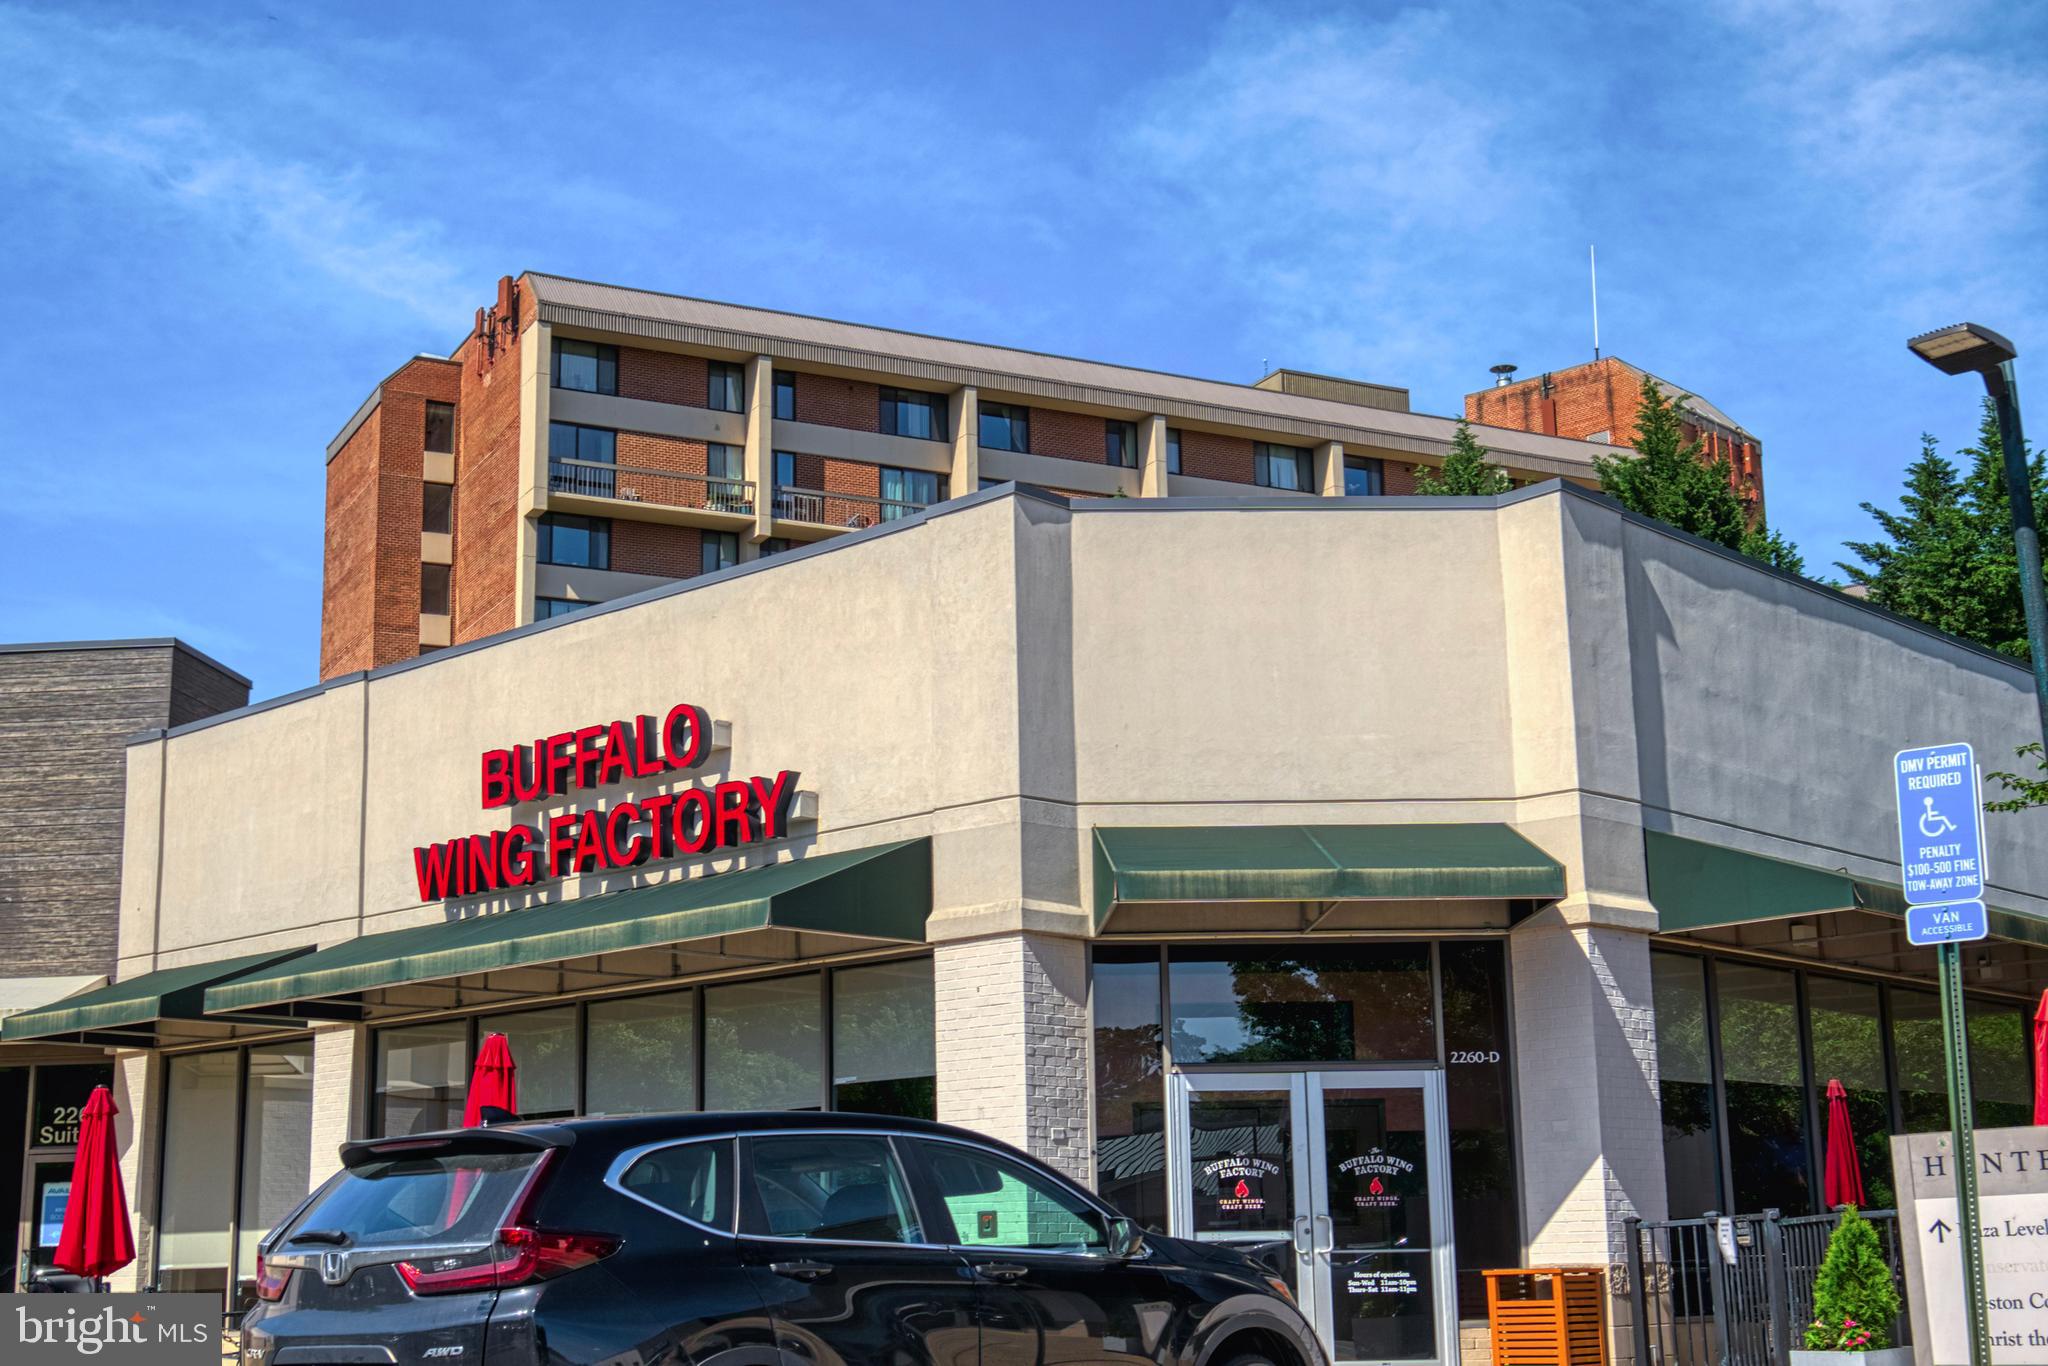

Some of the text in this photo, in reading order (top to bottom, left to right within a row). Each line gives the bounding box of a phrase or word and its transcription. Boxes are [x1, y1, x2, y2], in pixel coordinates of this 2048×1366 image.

[482, 704, 708, 809] BUFFALO
[1900, 752, 1967, 773] DMV PERMIT
[1908, 771, 1961, 790] REQUIRED
[414, 770, 801, 901] WING FACTORY
[1919, 843, 1961, 859] PENALTY
[1907, 858, 1977, 878] $100-500 FINE
[1907, 874, 1979, 892] TOW-AWAY ZONE
[1932, 911, 1960, 924] VAN
[1921, 922, 1974, 936] ACCESSIBLE
[1450, 1051, 1500, 1063] 2260-D
[40, 1125, 79, 1144] Suit
[1203, 1157, 1280, 1176] BUFFALO WING
[1338, 1155, 1414, 1173] BUFFALO WING
[1354, 1164, 1399, 1176] FACTORY
[1923, 1150, 2048, 1177] HNTE
[1219, 1167, 1264, 1179] FACTORY
[2028, 1329, 2048, 1347] th
[422, 1346, 464, 1358] AWD
